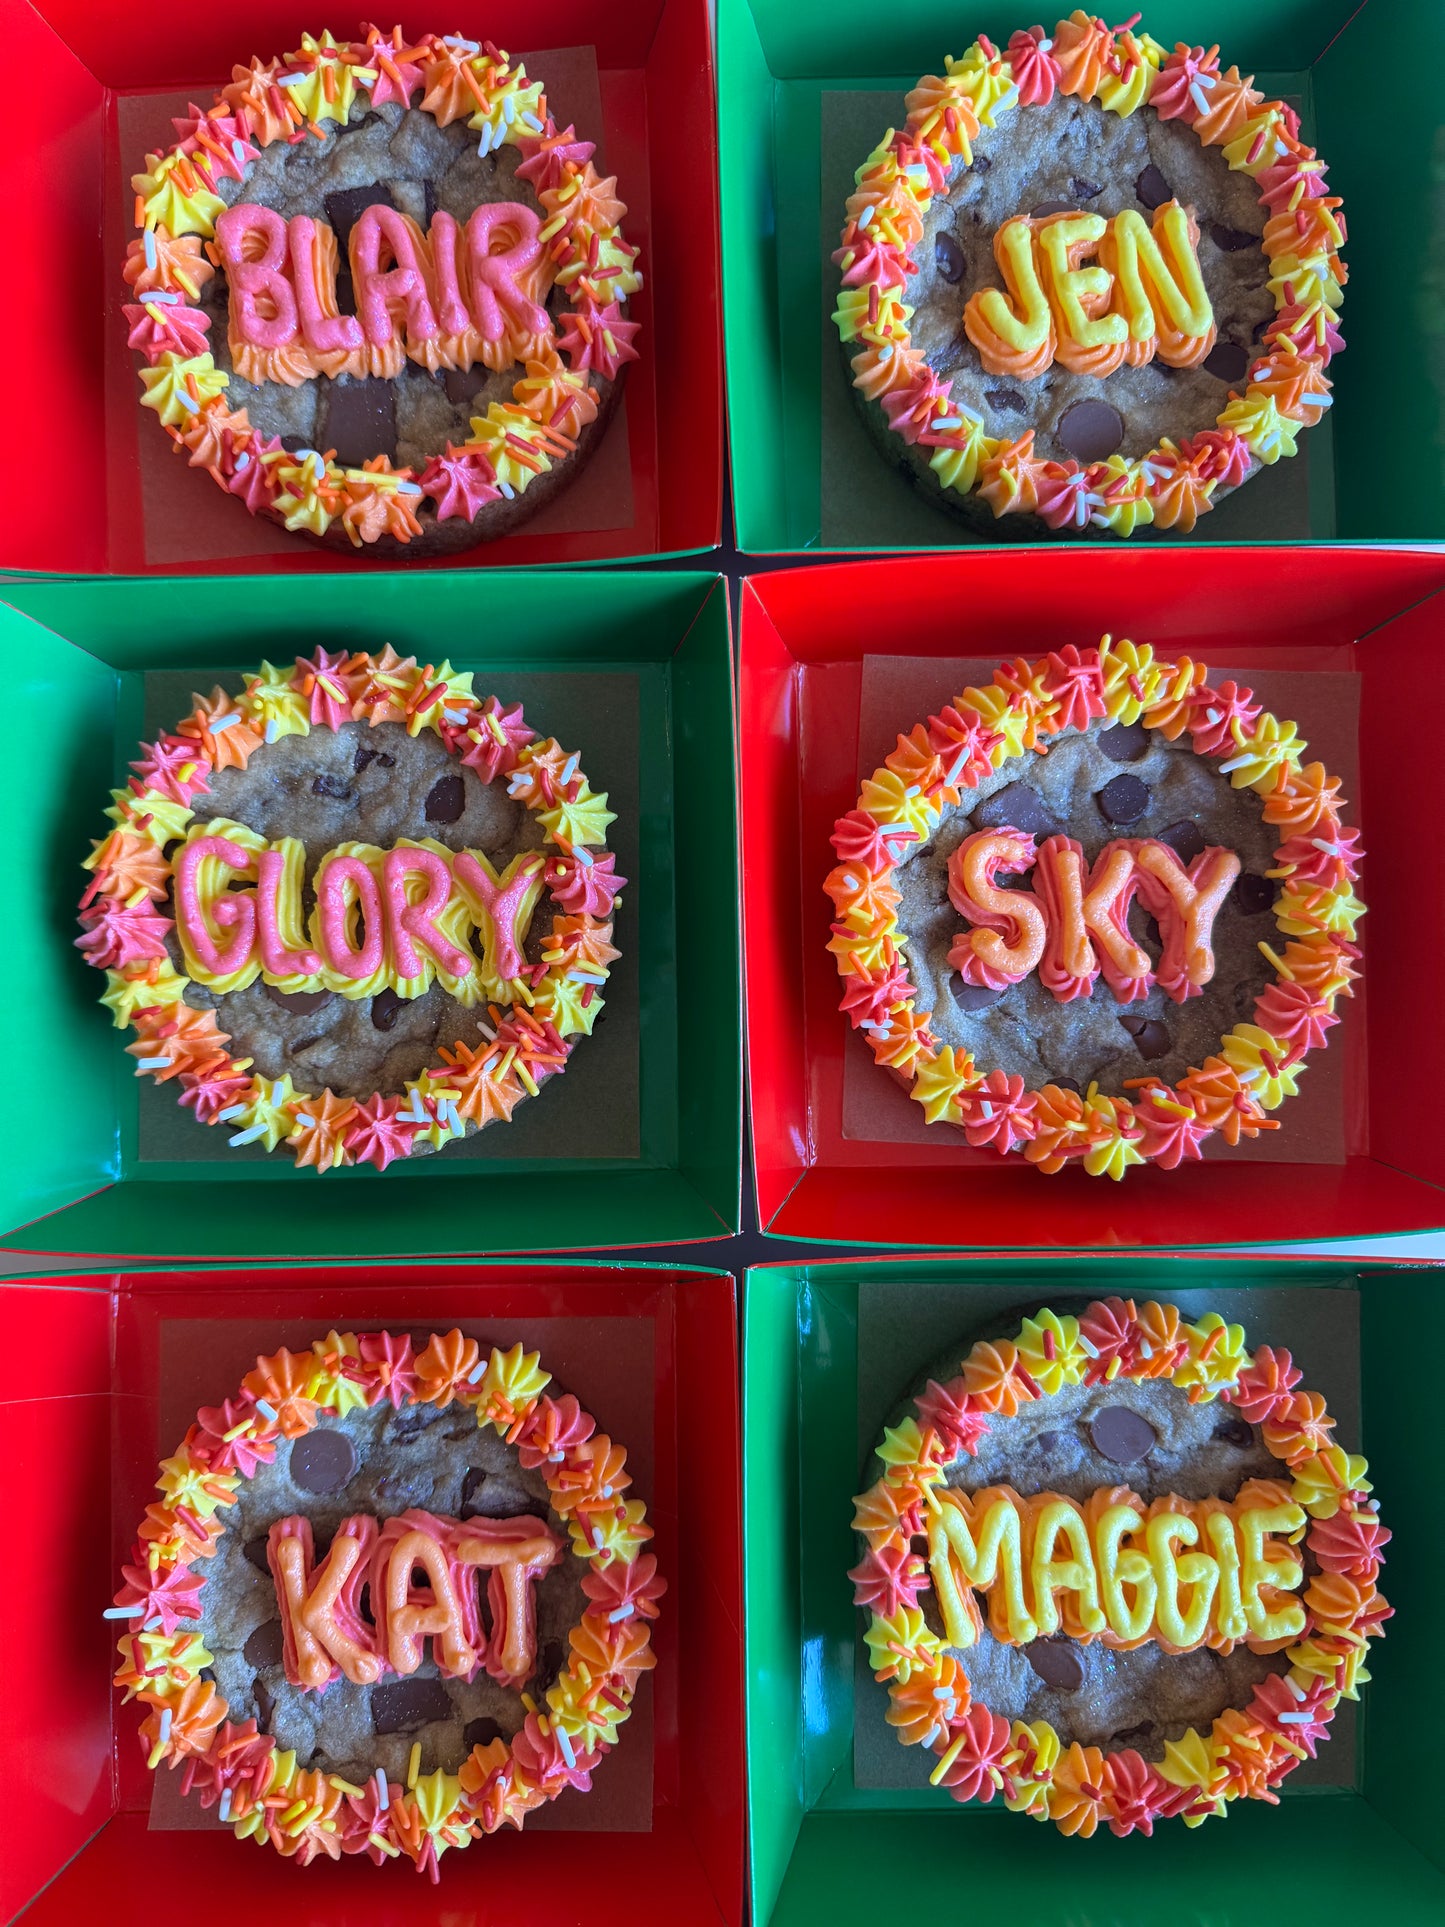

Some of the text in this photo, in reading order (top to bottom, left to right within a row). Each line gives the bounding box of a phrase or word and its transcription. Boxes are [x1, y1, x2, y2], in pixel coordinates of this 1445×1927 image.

[215, 202, 549, 351] BLAIR
[978, 206, 1213, 352] JEN
[179, 835, 544, 980] GLORY
[963, 836, 1241, 985] SKY
[277, 1530, 556, 1687] KAT
[928, 1500, 1307, 1648] MAGGIE
